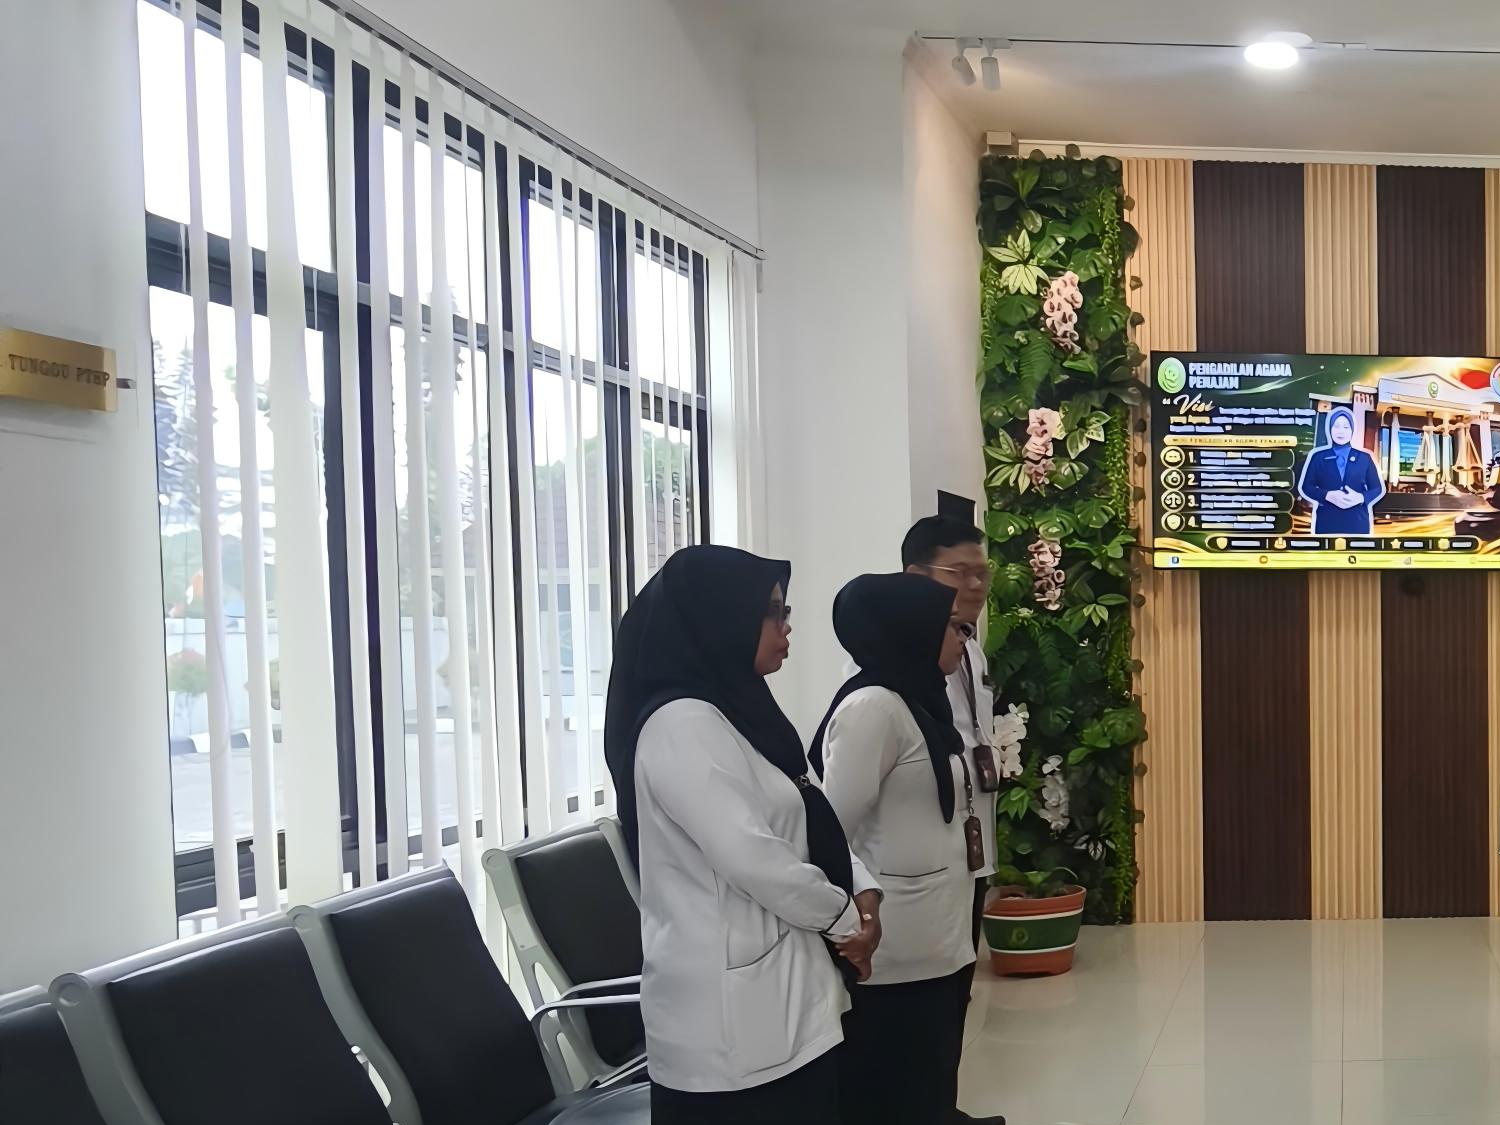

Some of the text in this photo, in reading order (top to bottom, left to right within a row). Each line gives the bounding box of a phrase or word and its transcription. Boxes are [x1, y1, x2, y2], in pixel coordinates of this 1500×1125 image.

[1188, 362, 1292, 377] PENGADILAN AGAMA
[1188, 376, 1240, 389] PENAJAM
